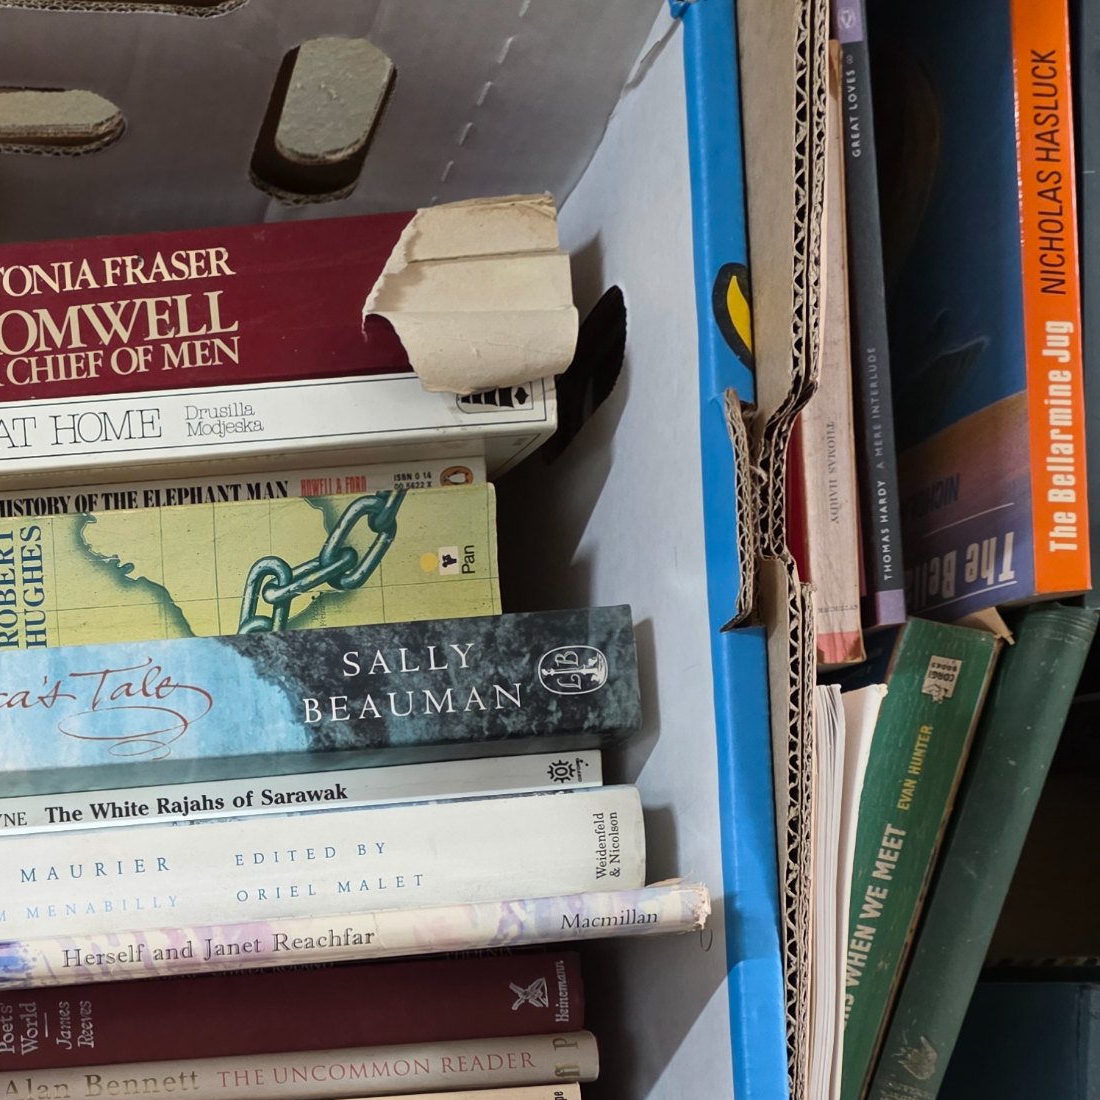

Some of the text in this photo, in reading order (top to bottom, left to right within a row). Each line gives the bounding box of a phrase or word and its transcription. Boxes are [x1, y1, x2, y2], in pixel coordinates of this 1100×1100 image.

[845, 69, 861, 158] GREAT LOVES
[1030, 50, 1066, 295] NICHOLAS HASLUCK
[102, 247, 236, 287] FRASER
[50, 408, 163, 446] HOME
[184, 401, 255, 421] Drusilla
[185, 417, 264, 438] Modjeska
[1042, 320, 1078, 553] The Bellarmine Jug
[866, 347, 892, 581] THOMAS HARDY A MERE INTERLUDE
[461, 544, 476, 574] Pan
[19, 524, 47, 649] HUGHES
[342, 643, 475, 677] SALLY
[302, 682, 523, 724] BEAUMAN
[44, 806, 84, 824] The
[89, 801, 150, 820] White
[156, 794, 226, 817] Rajahs
[232, 790, 255, 809] of
[260, 783, 348, 807] Sarawak
[235, 842, 386, 866] EDITED BY
[592, 811, 607, 880] Weidenfeld
[609, 811, 620, 878] & Nicolson
[20, 856, 171, 883] MAURIER
[236, 873, 425, 902] ORIEL MALET
[26, 895, 178, 919] MENABILLY
[61, 944, 146, 968] Herself
[152, 940, 194, 962] and
[203, 937, 262, 961] Janet
[272, 928, 376, 952] Reachfar
[559, 909, 658, 930] Macmillan
[555, 960, 569, 1023] Heinemann
